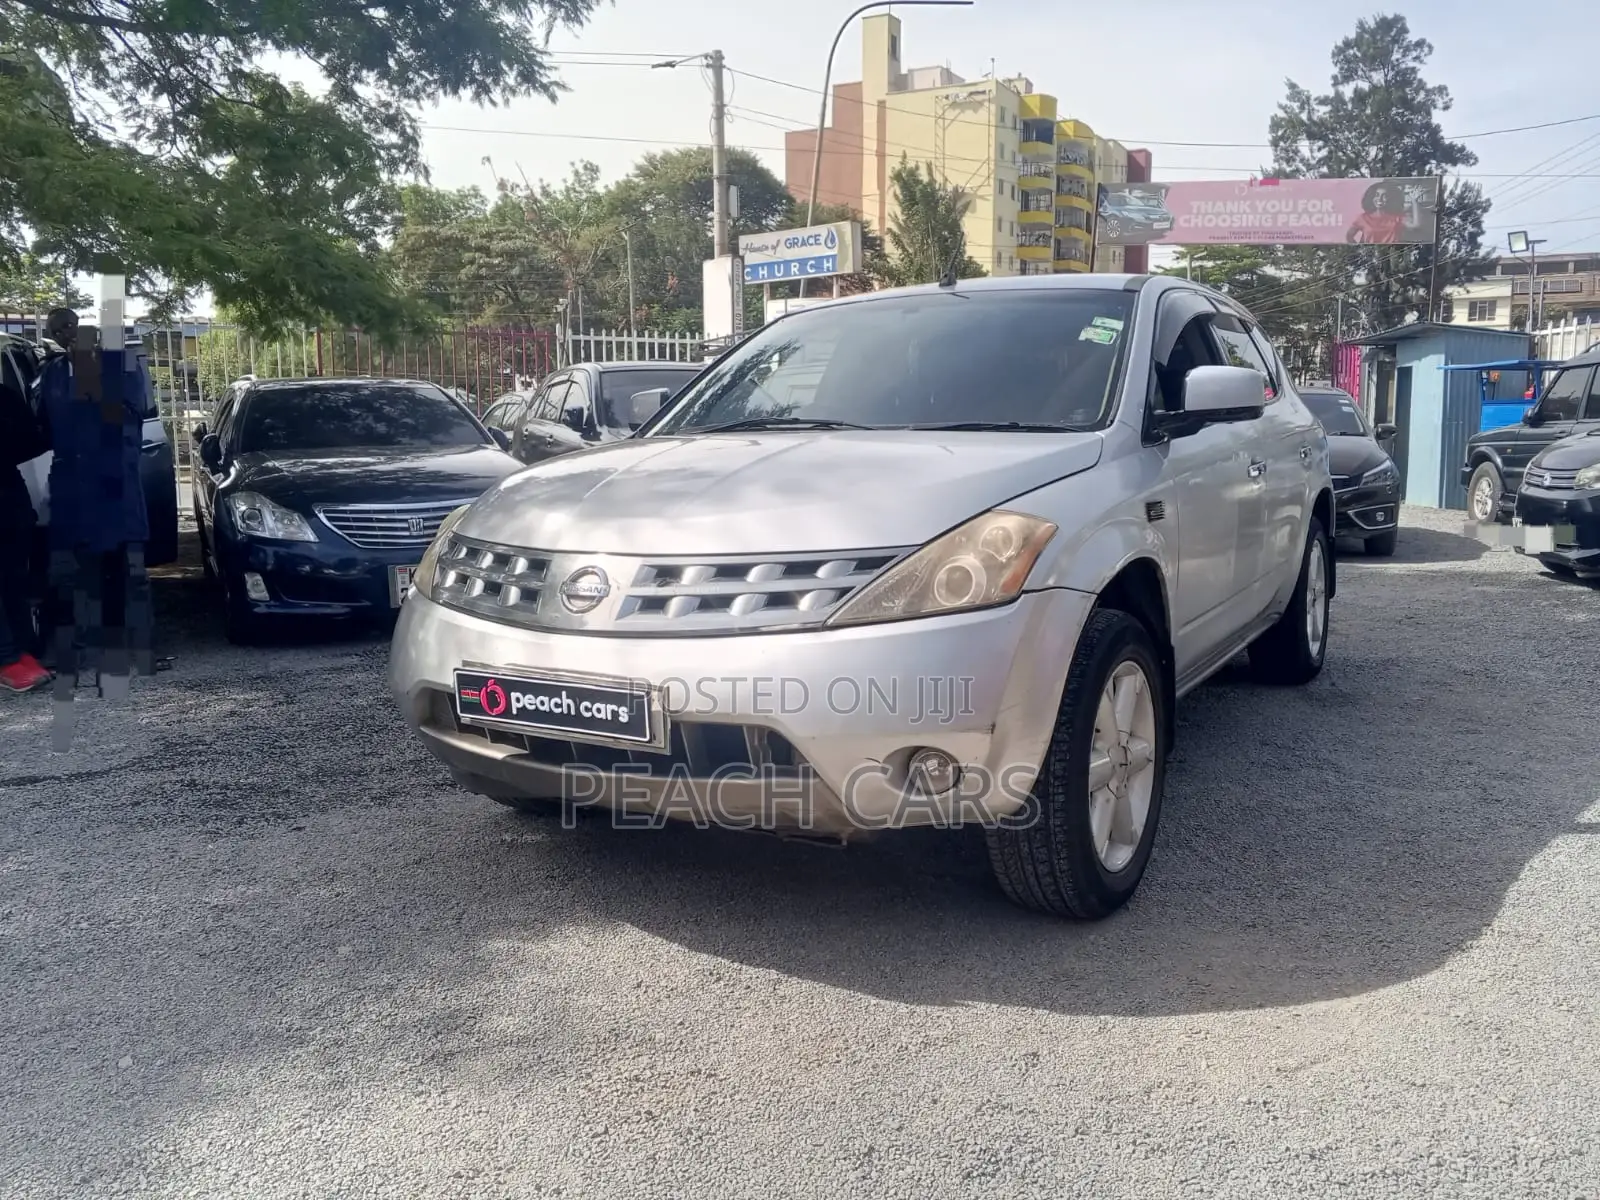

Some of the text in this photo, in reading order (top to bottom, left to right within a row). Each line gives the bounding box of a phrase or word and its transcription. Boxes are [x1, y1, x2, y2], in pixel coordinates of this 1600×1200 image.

[1190, 199, 1334, 214] THANK YOU FOR
[1179, 213, 1343, 228] CHOOSING PEACH!
[784, 233, 822, 250] GRACE
[744, 257, 833, 280] CHURCH
[510, 690, 629, 723] peach cars
